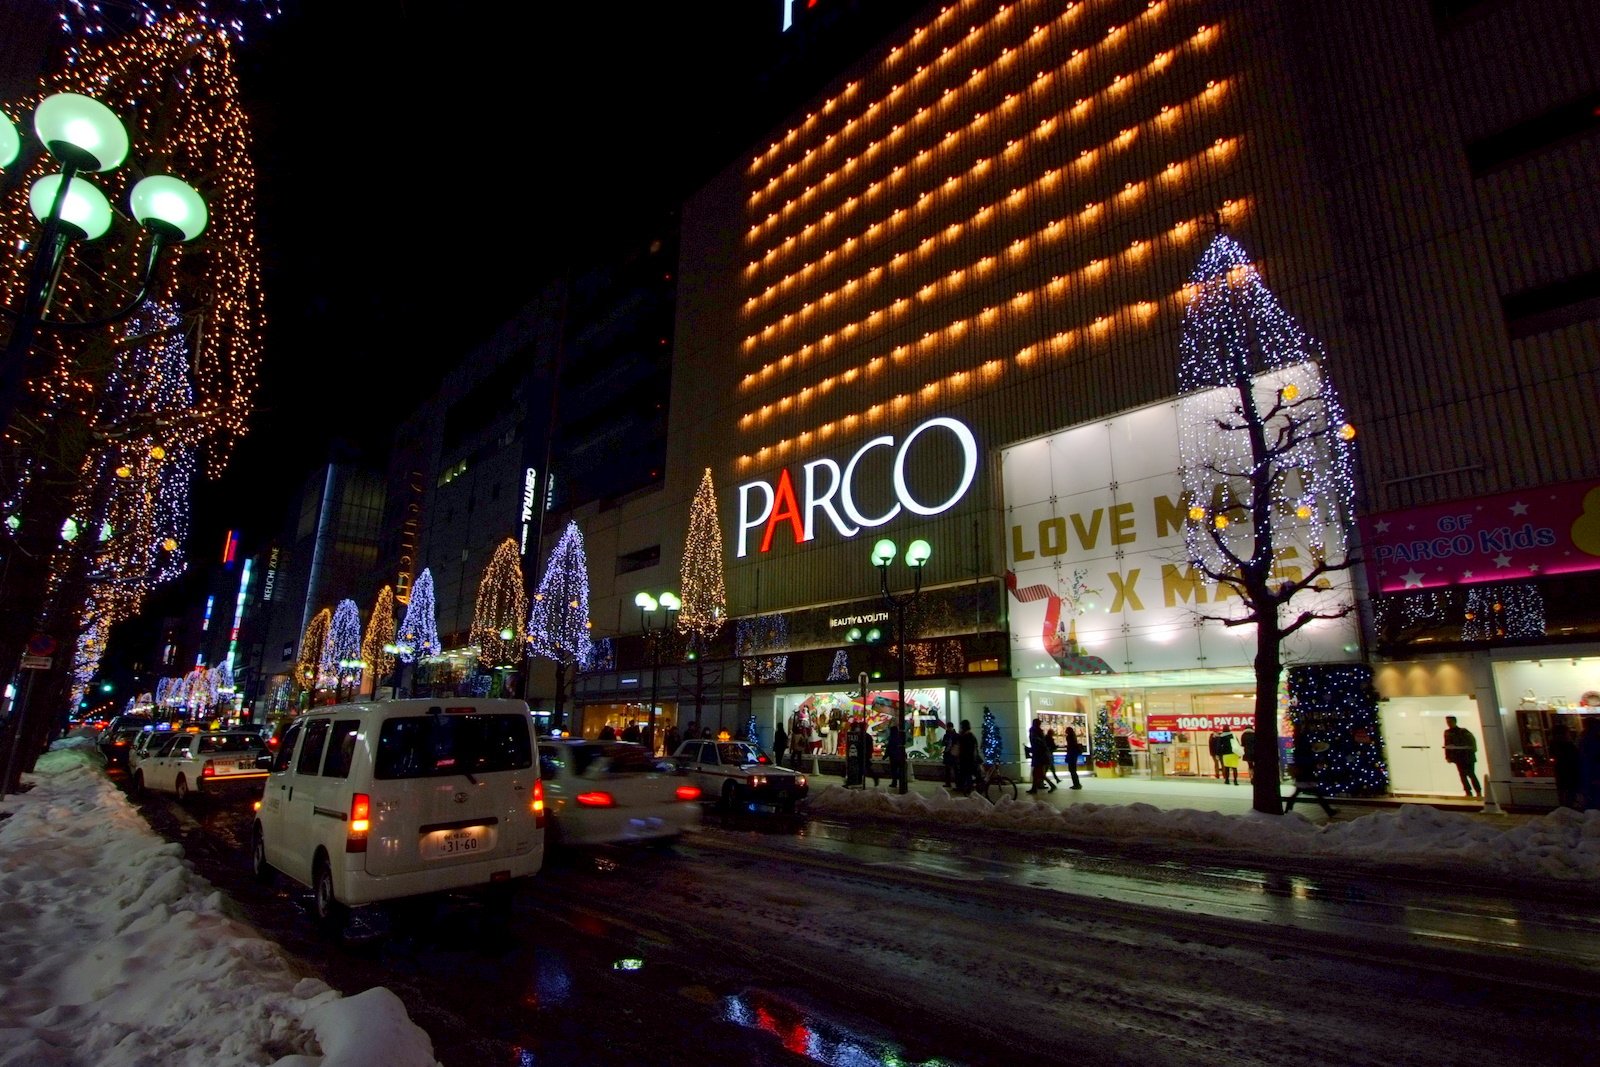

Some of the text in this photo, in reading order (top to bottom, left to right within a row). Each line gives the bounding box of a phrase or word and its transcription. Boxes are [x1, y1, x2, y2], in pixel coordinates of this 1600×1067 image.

[521, 467, 537, 523] CENTRAL
[736, 417, 978, 558] PARCO
[1011, 502, 1137, 563] LOVE
[1374, 523, 1557, 565] PARCO Kids
[1437, 514, 1473, 533] 6F
[263, 546, 280, 601] IKEUCHI ZONE
[1107, 567, 1146, 614] X
